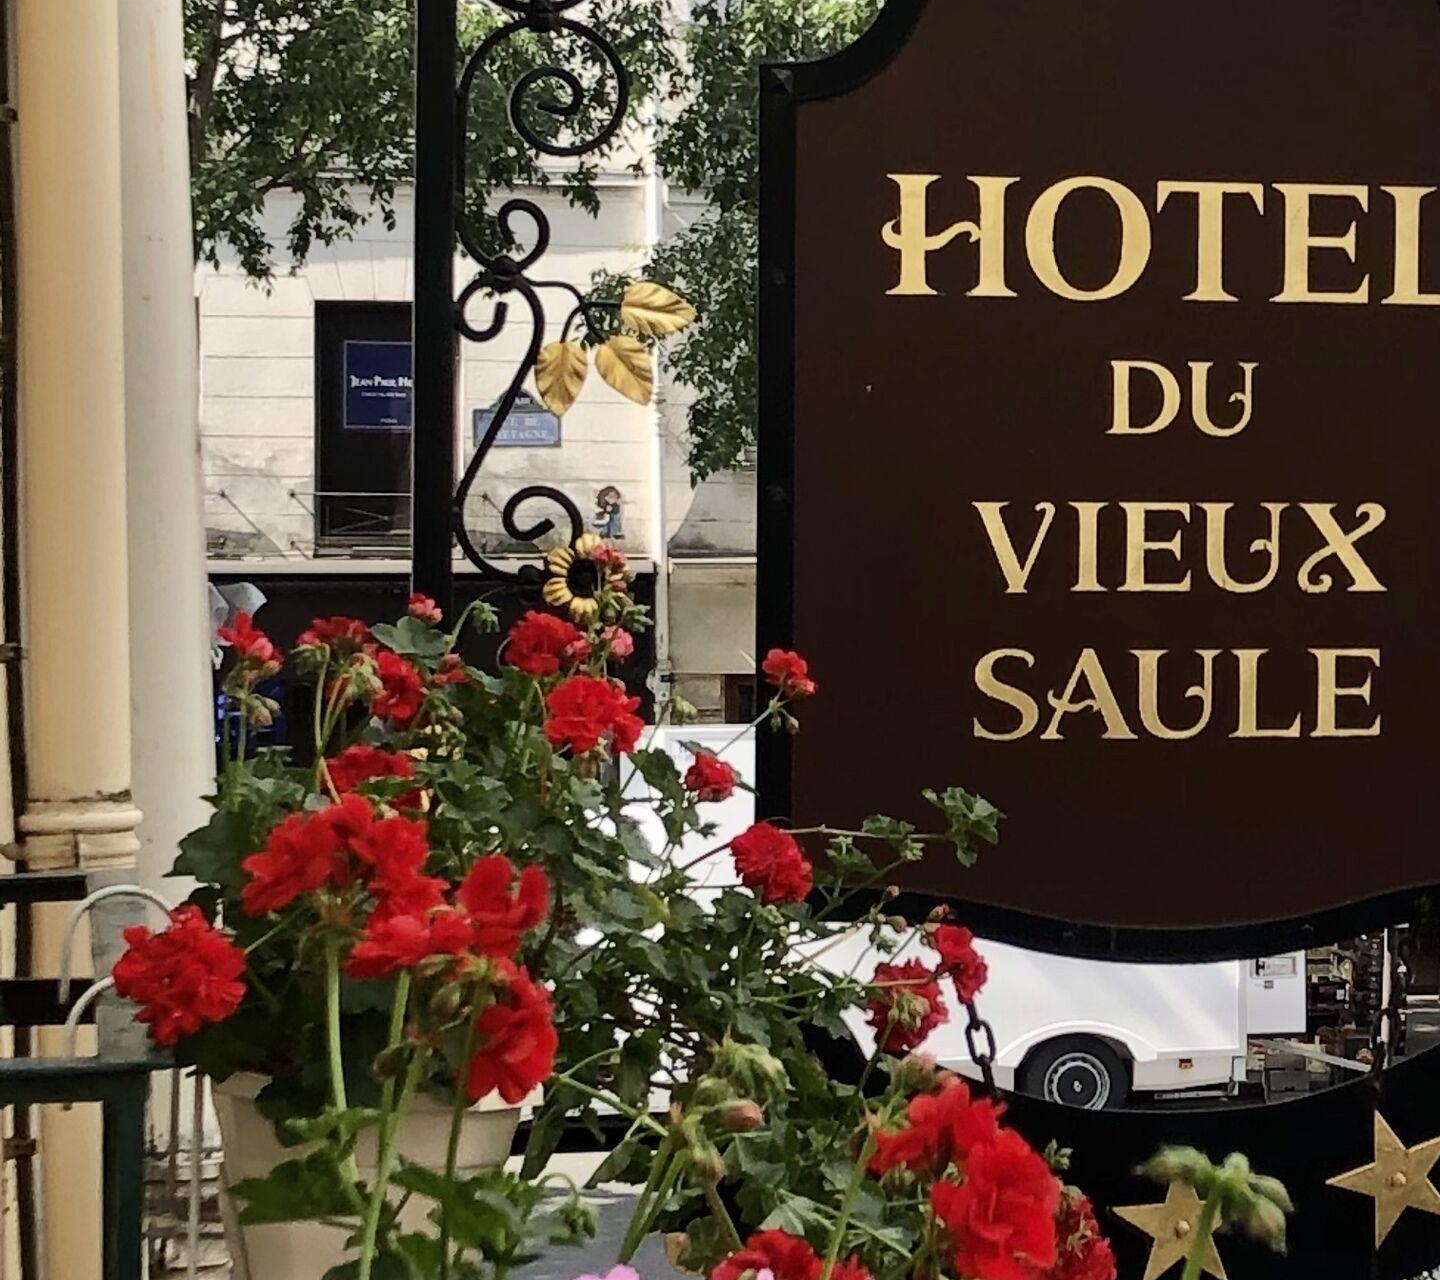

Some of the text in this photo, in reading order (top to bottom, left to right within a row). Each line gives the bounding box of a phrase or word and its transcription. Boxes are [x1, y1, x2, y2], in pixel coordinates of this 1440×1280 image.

[1105, 359, 1260, 437] DU
[971, 501, 1388, 594] VIEUX
[972, 647, 1382, 740] SAULE
